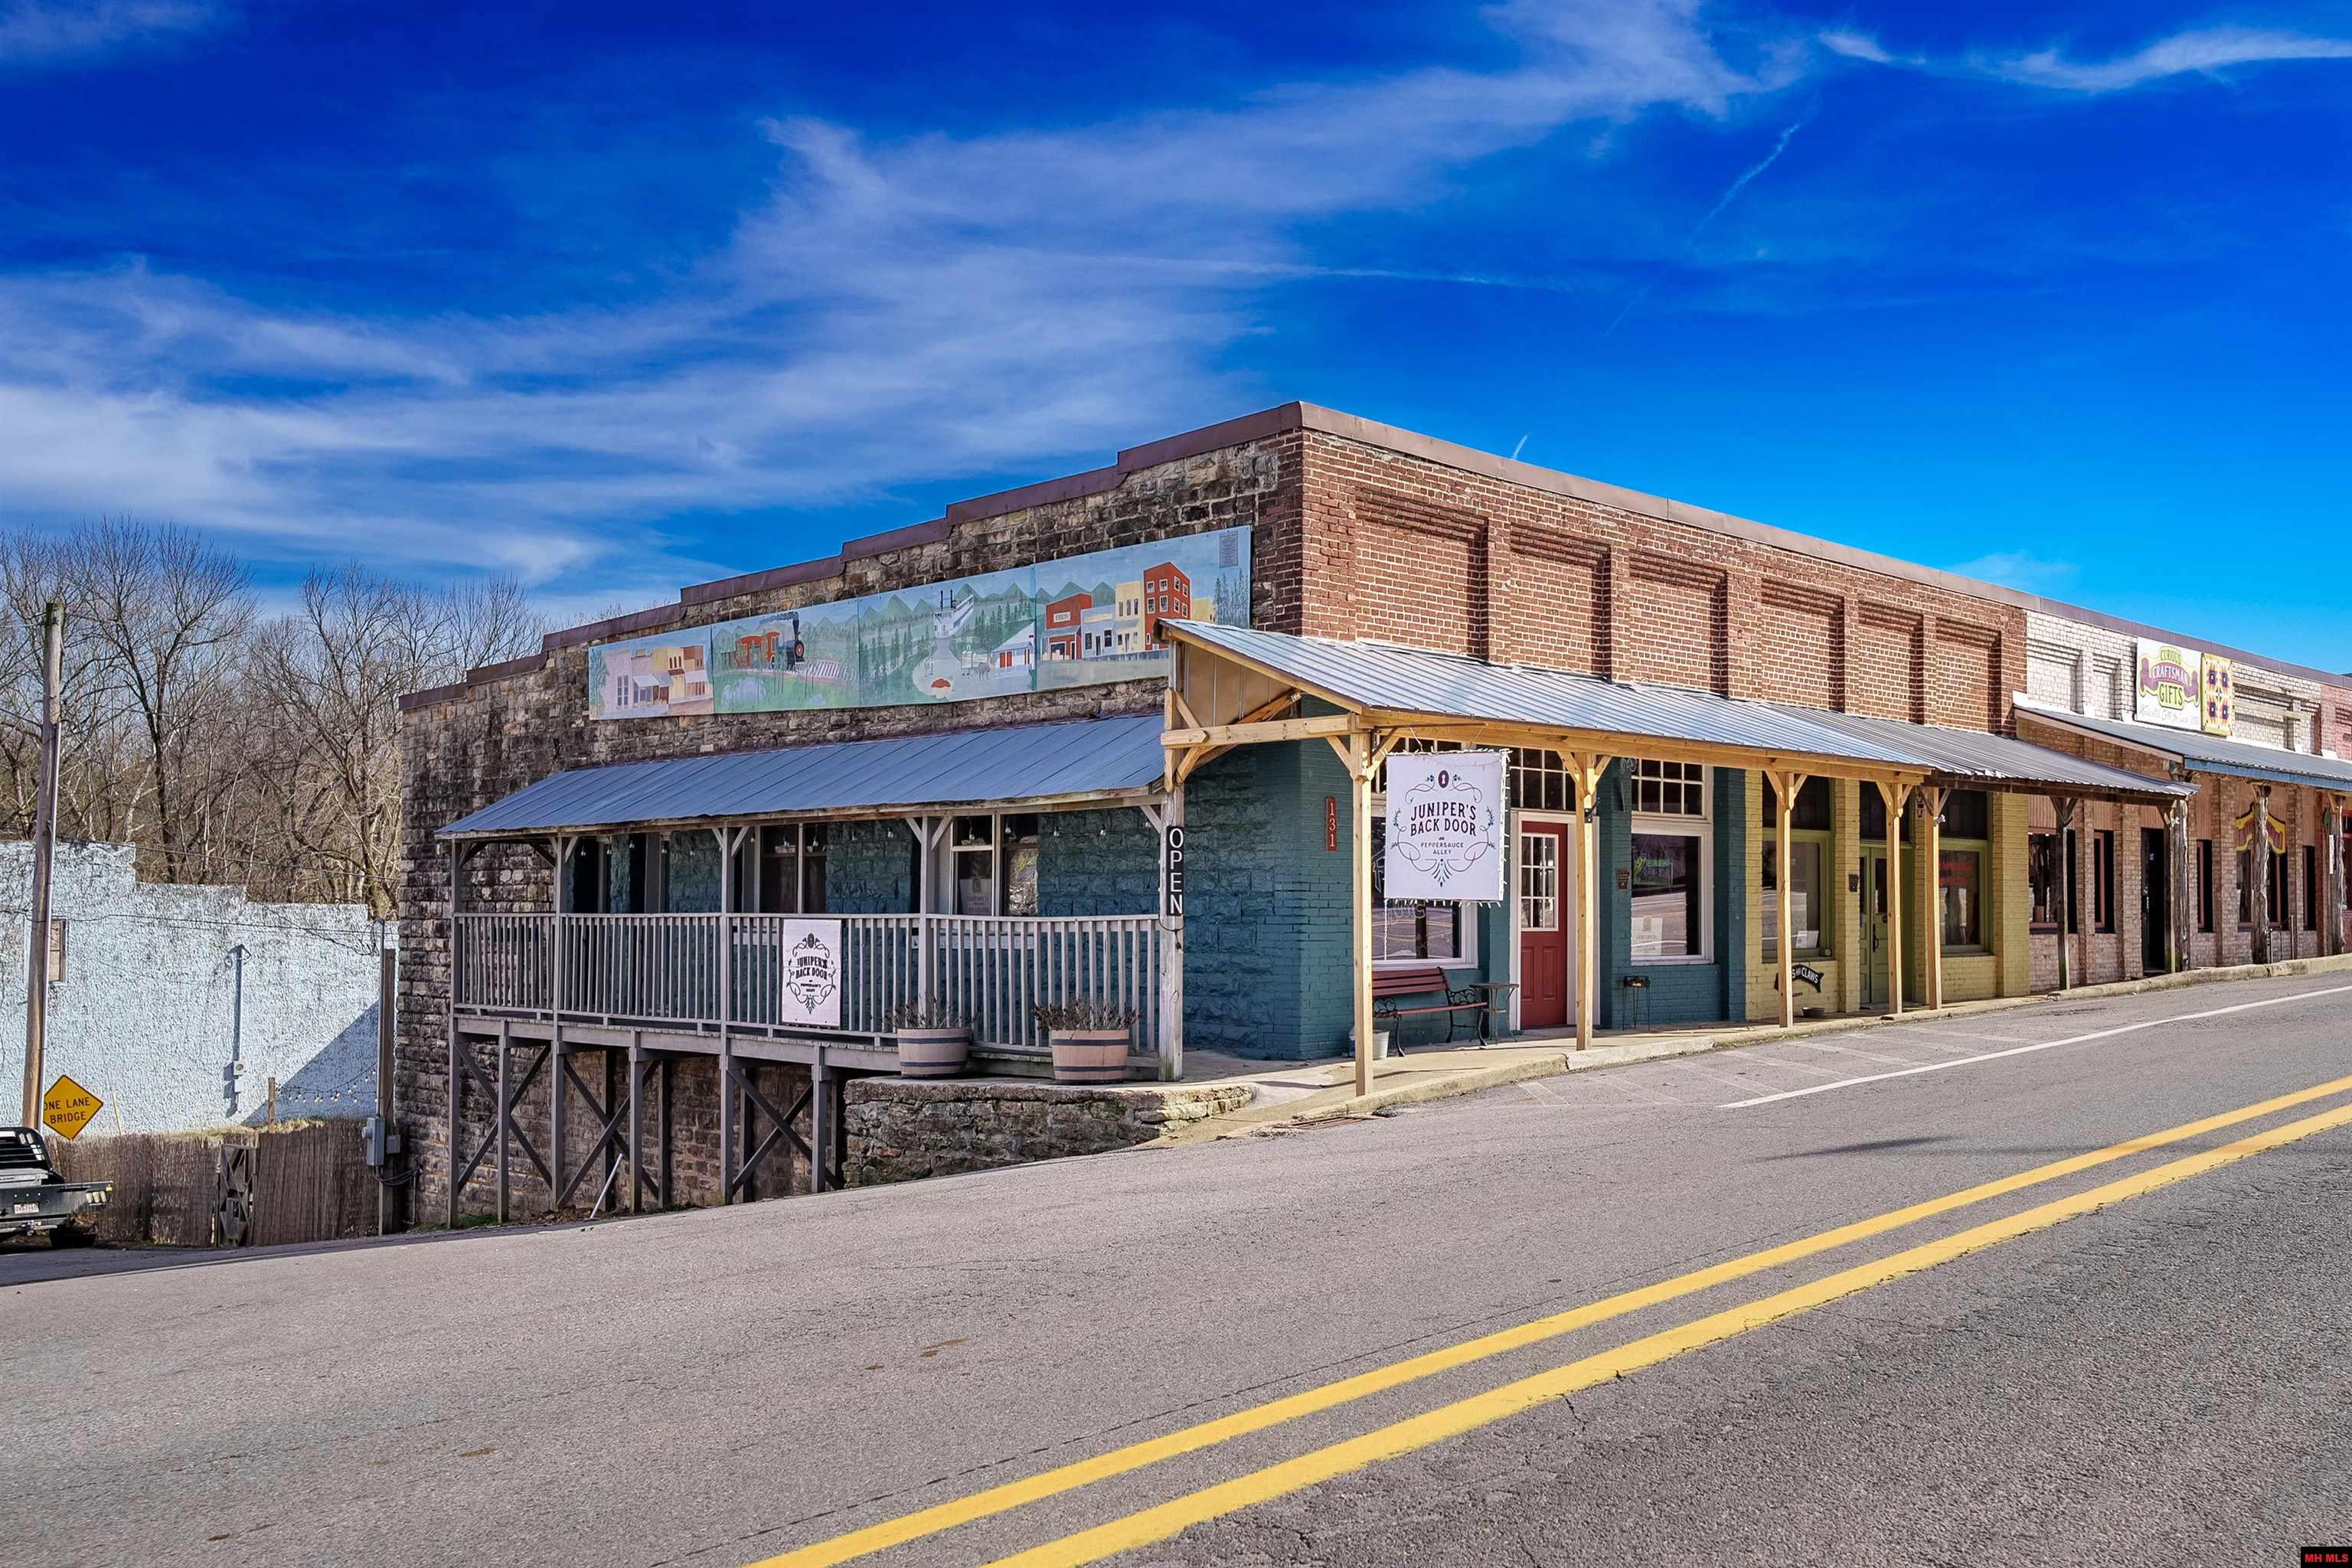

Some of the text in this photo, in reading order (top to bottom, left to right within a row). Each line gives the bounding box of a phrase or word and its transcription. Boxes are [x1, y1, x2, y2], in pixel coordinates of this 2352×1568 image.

[2160, 649, 2181, 665] CURIOUS
[2151, 665, 2189, 687] CRAFTSMAN
[2159, 683, 2183, 706] GIFTS
[1410, 802, 1476, 822] JUNIPER'S
[1410, 818, 1476, 837] BACK DOOR
[1169, 828, 1184, 914] OPEN
[797, 956, 828, 969] JUNIPER'S
[795, 967, 828, 981] BACK DOOR
[1801, 967, 1819, 984] CLAWS
[66, 1096, 91, 1109] LANE
[49, 1111, 87, 1125] BRIDGE
